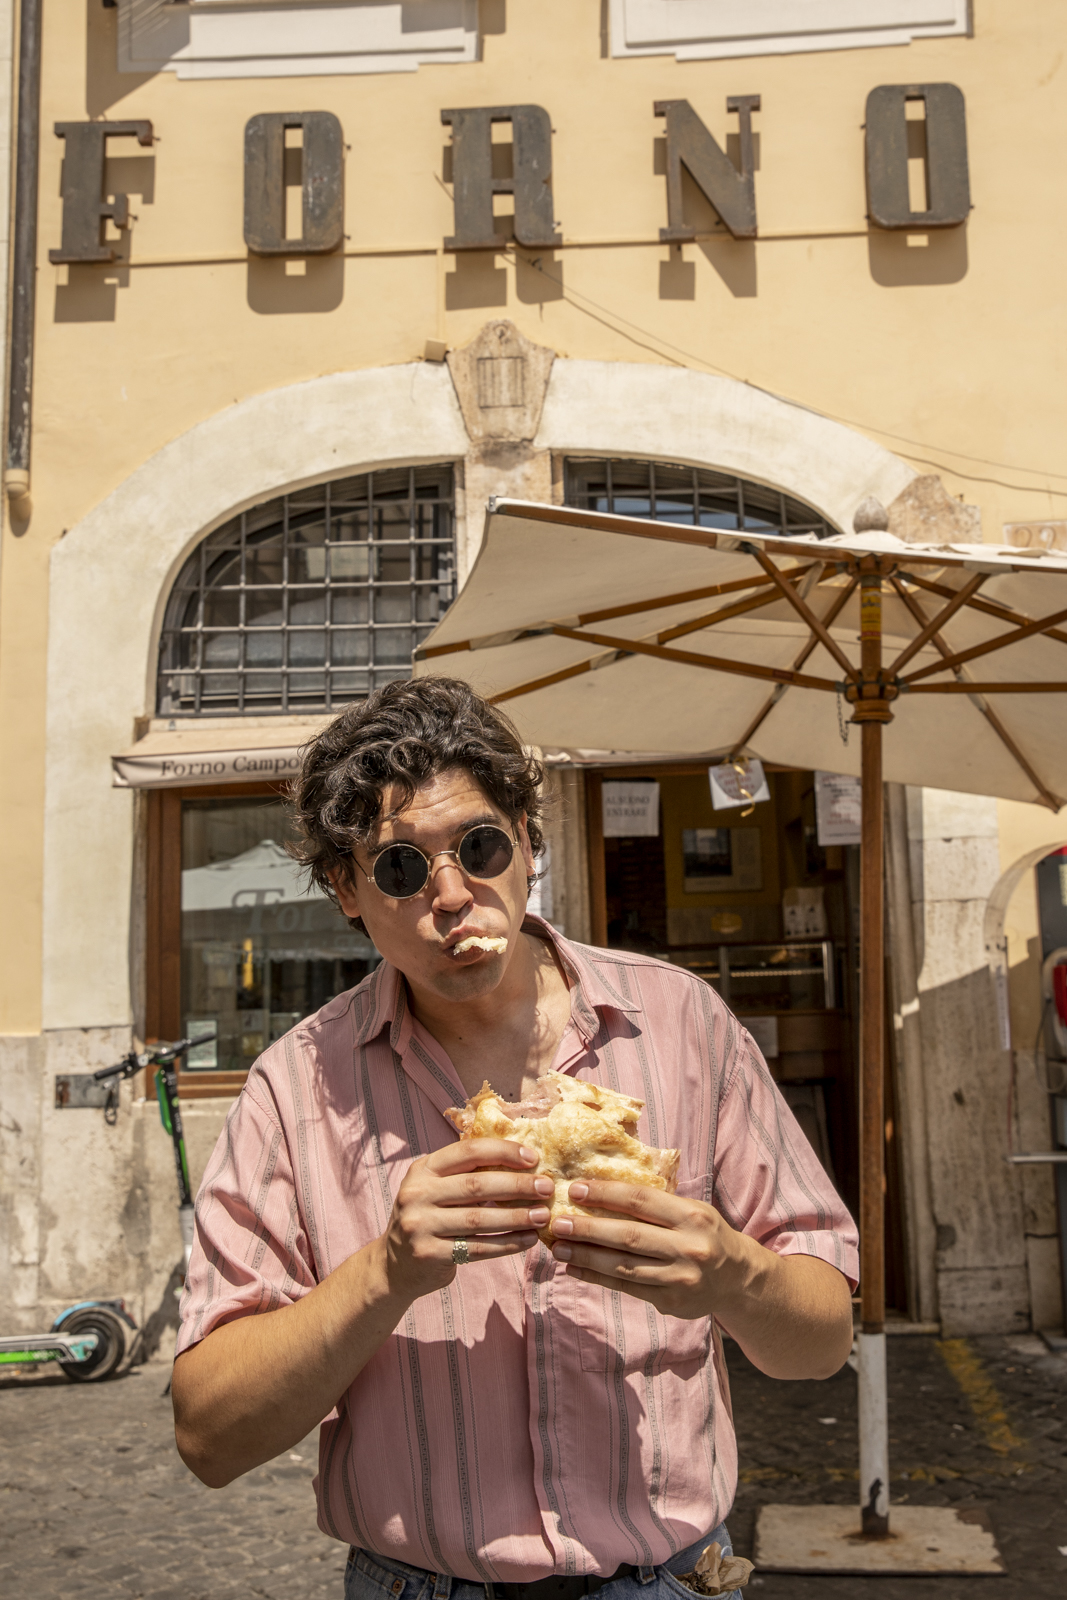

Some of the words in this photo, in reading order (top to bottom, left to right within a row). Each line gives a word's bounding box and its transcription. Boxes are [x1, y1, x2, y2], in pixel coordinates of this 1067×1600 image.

[49, 82, 971, 265] FORNO
[161, 760, 226, 778] Forno
[232, 755, 300, 775] Campo
